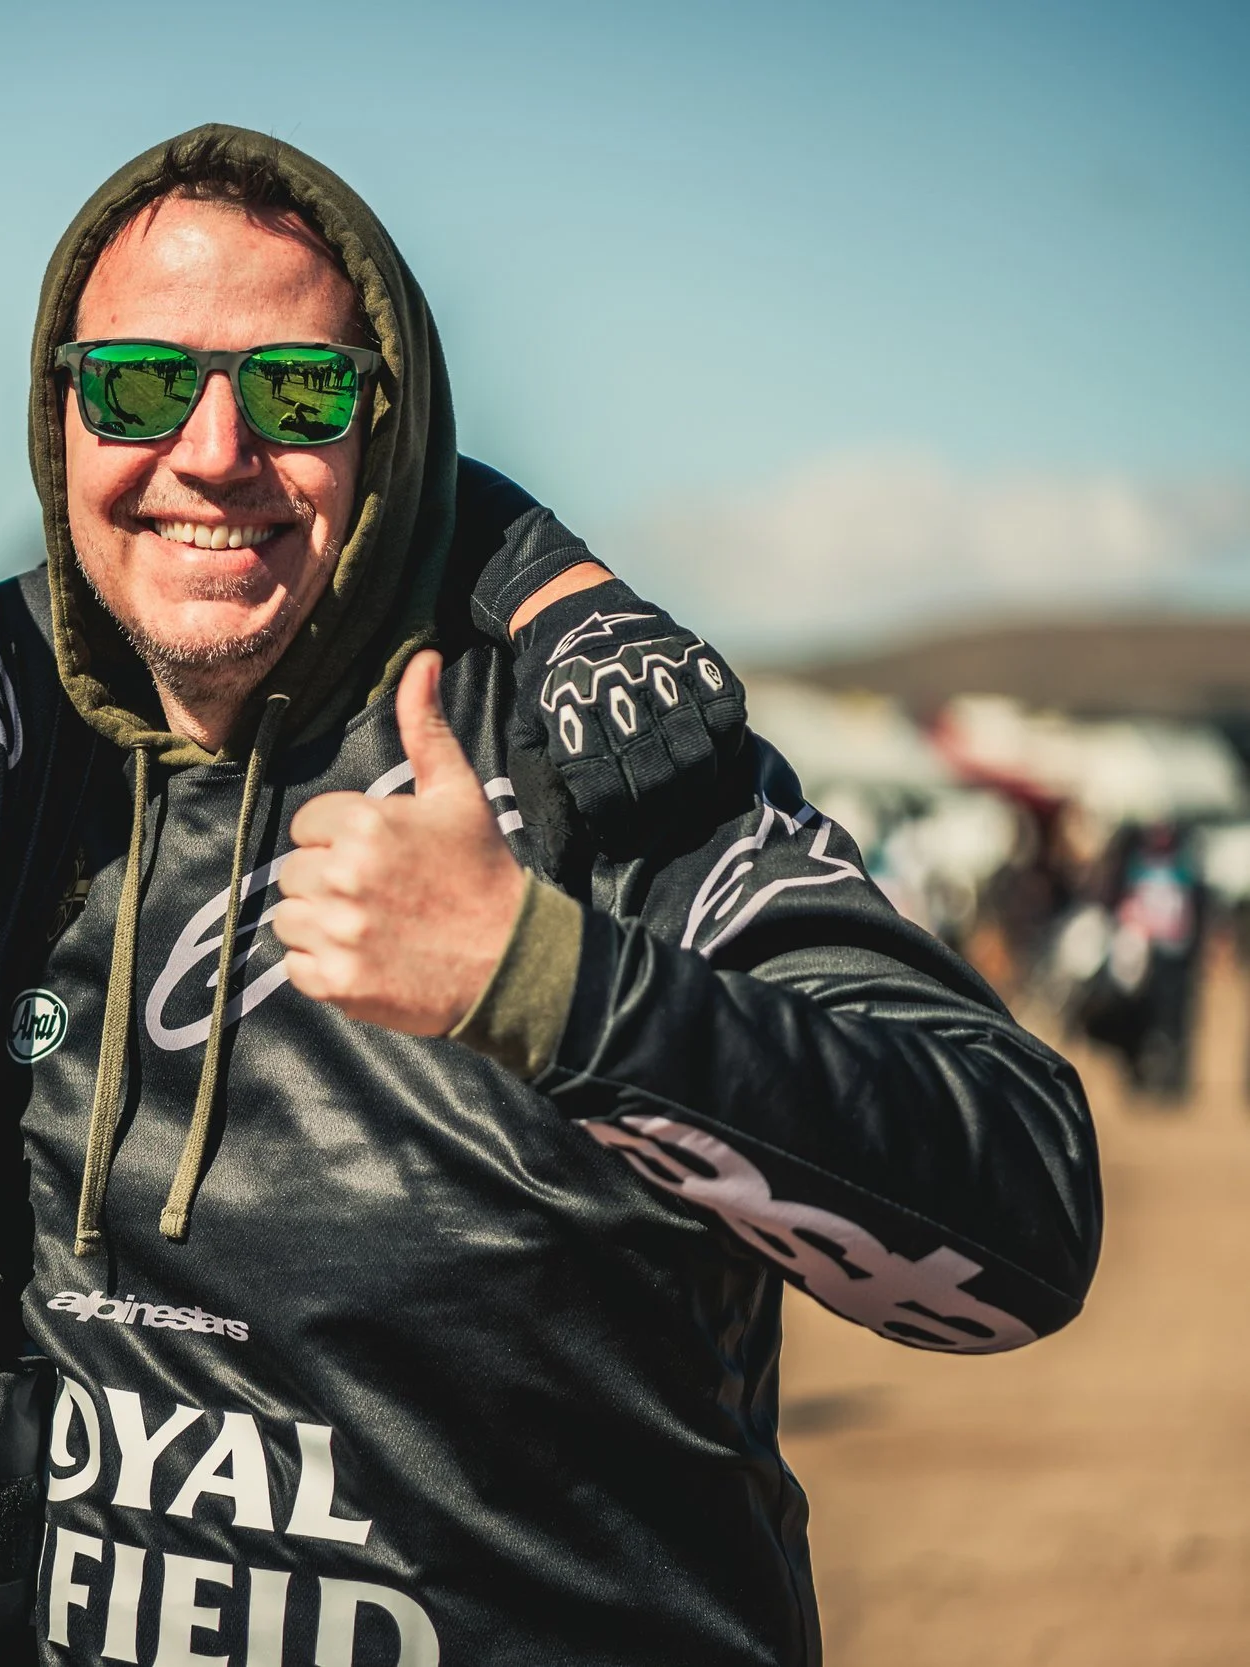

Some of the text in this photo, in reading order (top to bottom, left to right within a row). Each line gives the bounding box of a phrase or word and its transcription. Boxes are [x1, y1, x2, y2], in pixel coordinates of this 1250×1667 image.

[11, 1000, 60, 1041] Arai
[47, 1290, 249, 1341] alpinestars
[47, 1375, 372, 1546] OYAL
[45, 1526, 440, 1667] FIELD
